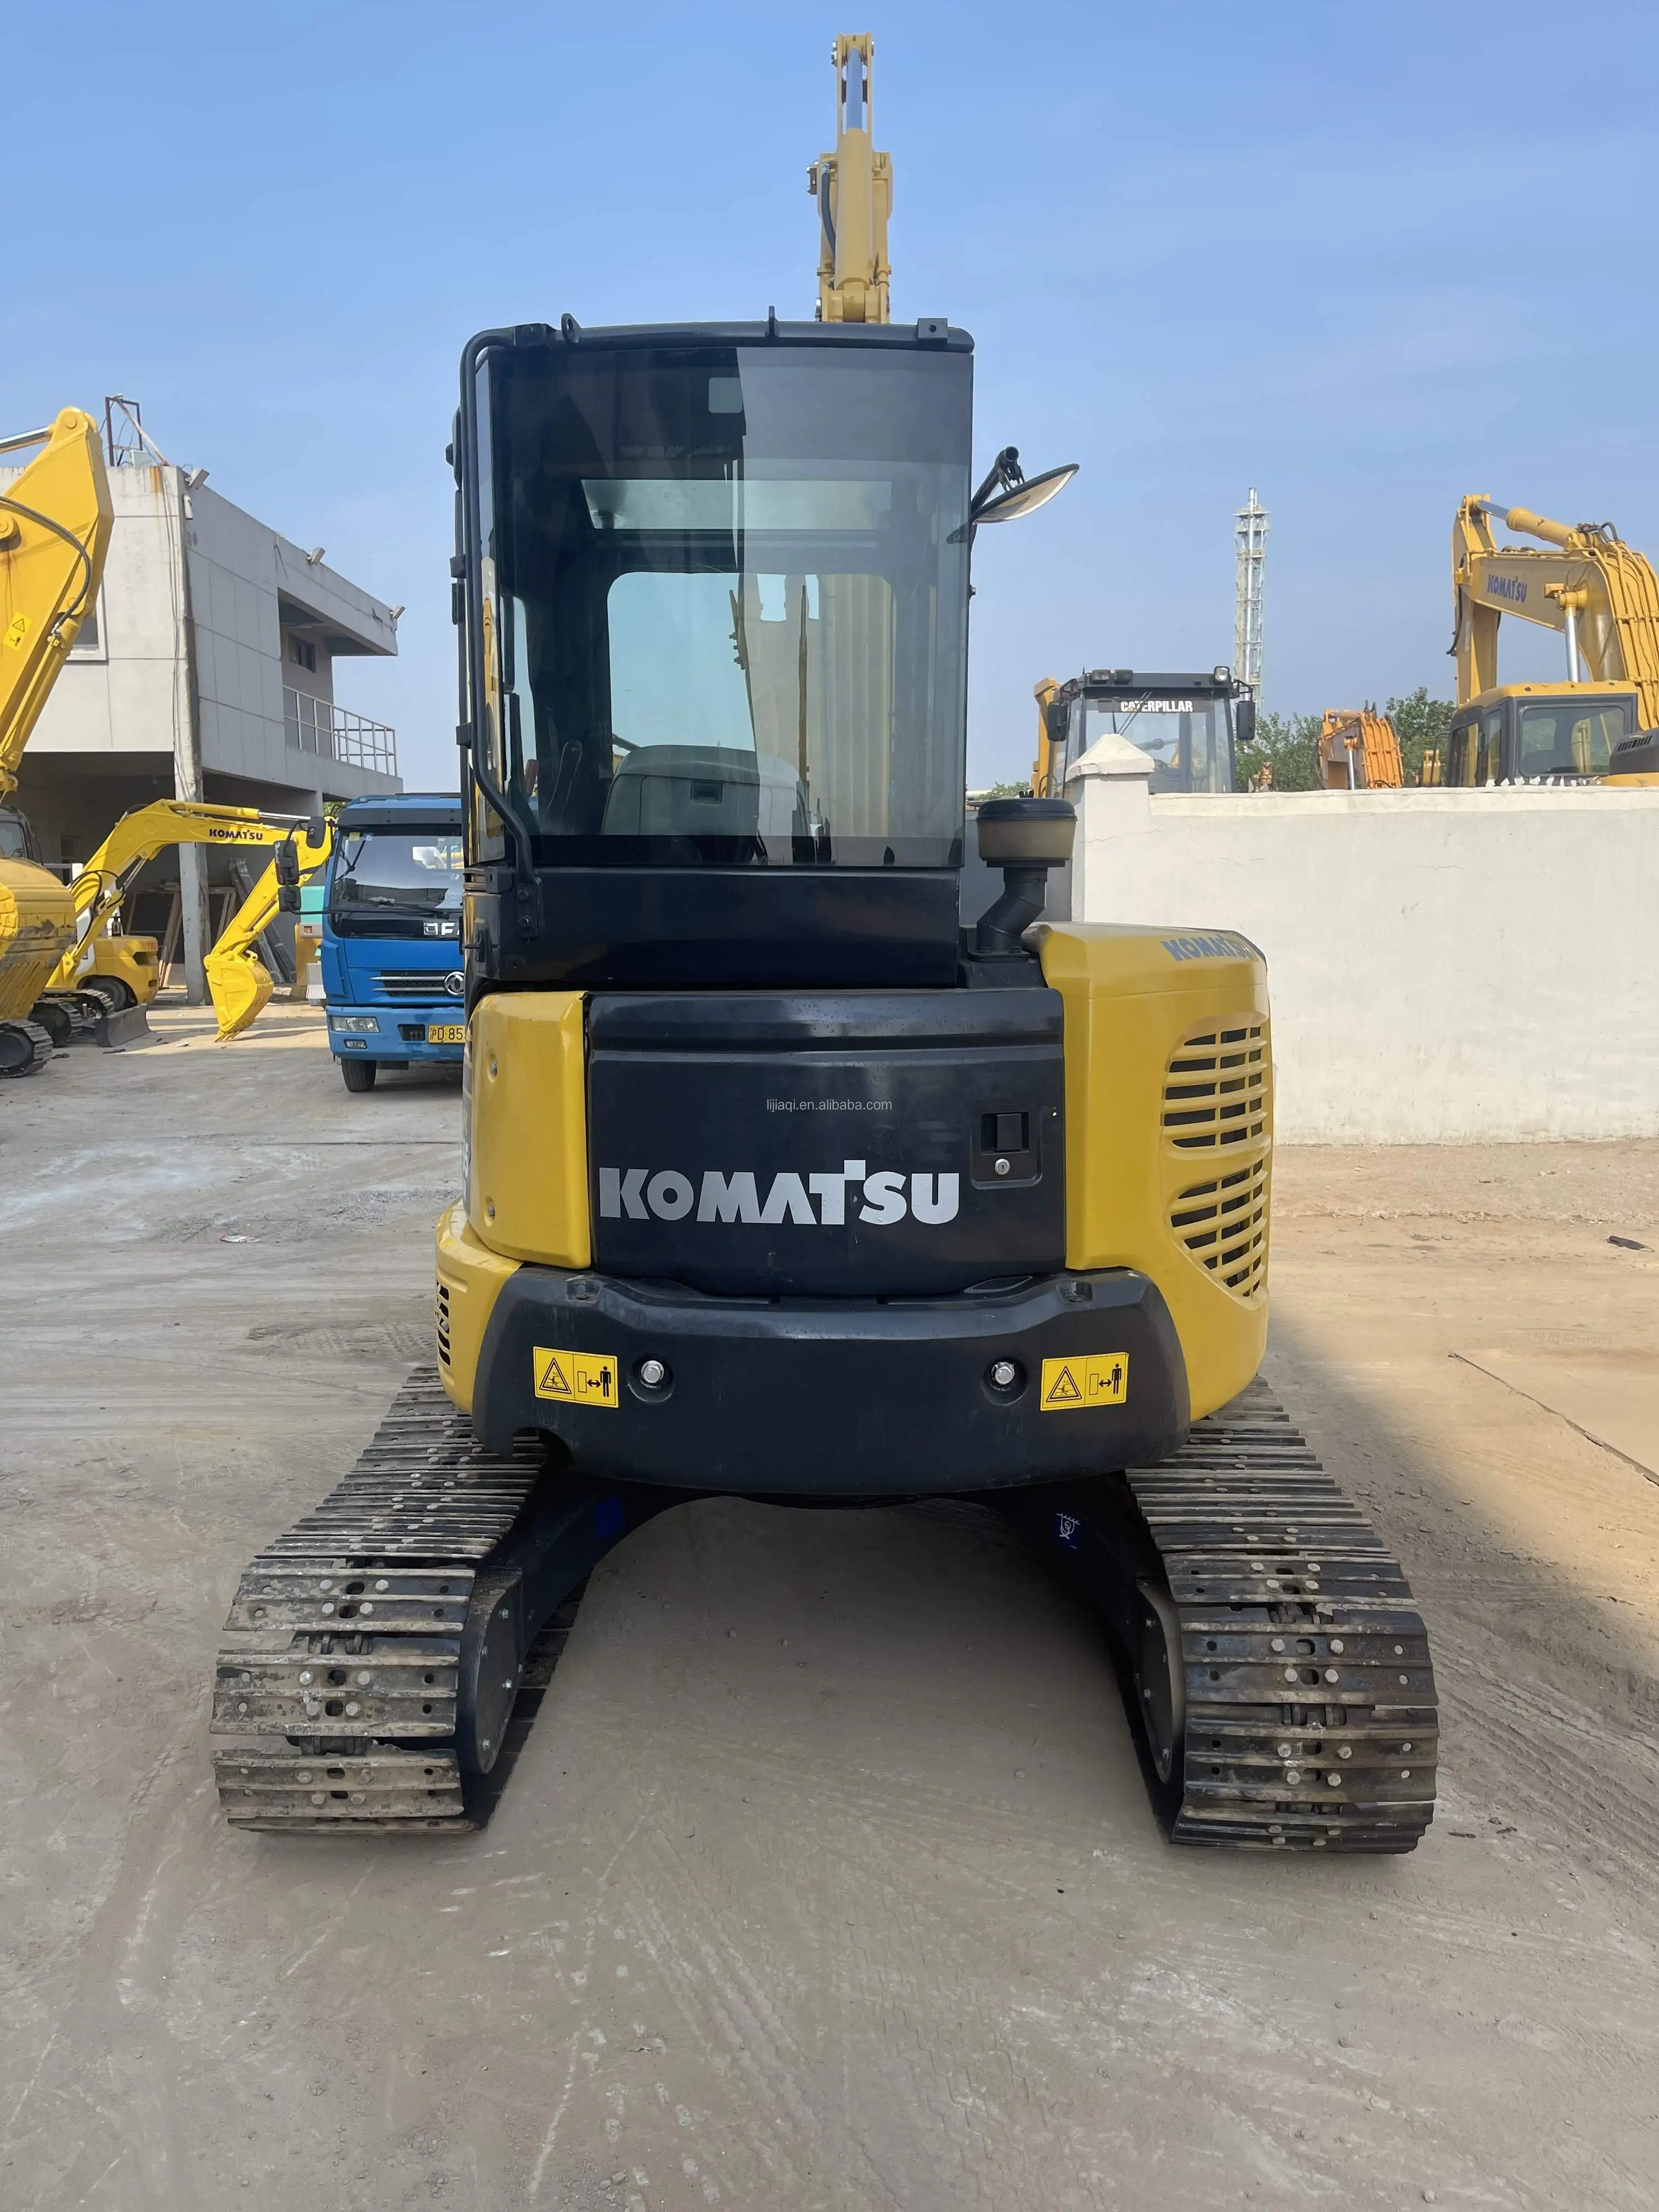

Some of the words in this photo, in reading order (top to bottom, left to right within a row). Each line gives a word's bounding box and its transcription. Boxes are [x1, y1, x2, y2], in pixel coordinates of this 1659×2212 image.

[1487, 574, 1527, 603] KOMATSU
[1120, 700, 1193, 712] CATERPILLAR
[209, 829, 263, 840] KOMATSU
[423, 922, 460, 935] DF
[599, 1160, 960, 1225] KOMATSU
